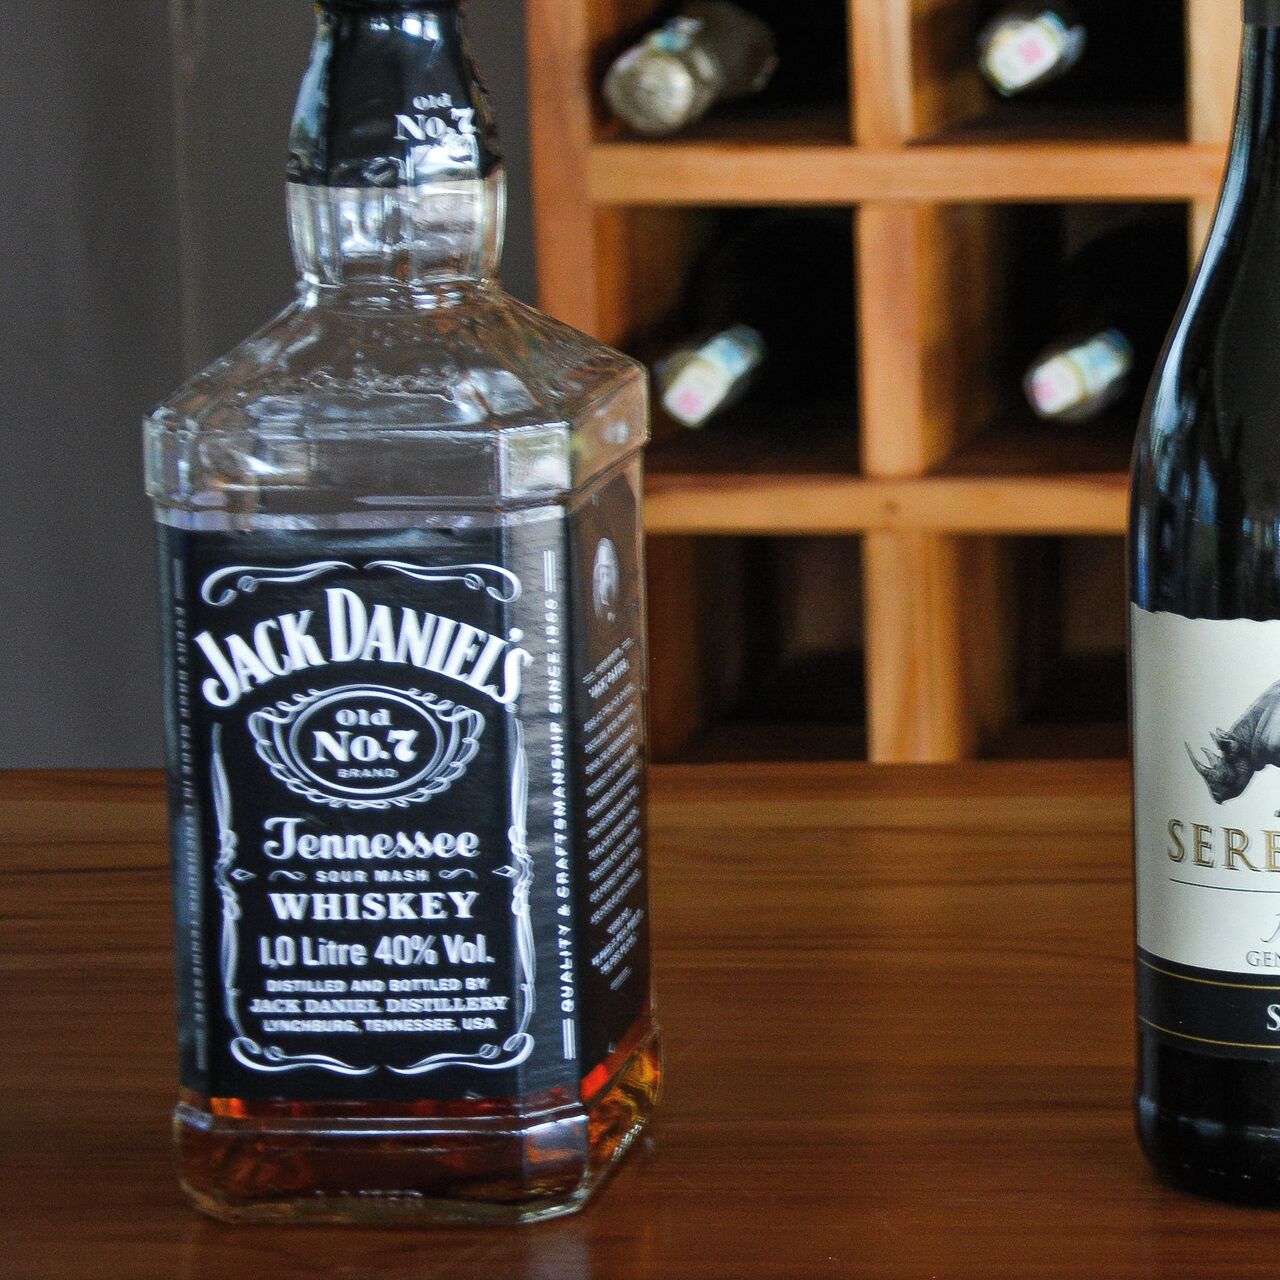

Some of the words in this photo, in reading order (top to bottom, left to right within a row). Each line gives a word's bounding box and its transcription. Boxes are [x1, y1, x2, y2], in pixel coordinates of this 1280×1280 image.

[193, 609, 328, 708] JACK
[325, 587, 534, 704] DANIEL'S
[547, 651, 563, 715] SINCE
[312, 729, 419, 763] No.7
[337, 767, 399, 779] BRAND
[549, 721, 571, 899] CRAFTSMANSHIP
[263, 817, 480, 860] Tennessee
[315, 869, 367, 883] SOUR
[374, 869, 431, 882] MASH
[269, 891, 480, 921] WHISKEY
[301, 935, 369, 966] Litre
[373, 934, 440, 966] 40%
[442, 933, 496, 965] Vol.
[558, 924, 575, 1012] QUALITY
[265, 979, 348, 993] DISTILLED
[350, 979, 386, 992] AND
[388, 978, 463, 992] BOTTLED
[464, 977, 490, 991] BY
[248, 998, 302, 1013] JACK
[303, 998, 384, 1013] DANIEL
[384, 995, 511, 1013] DISTILLERY
[461, 1017, 498, 1030] USA
